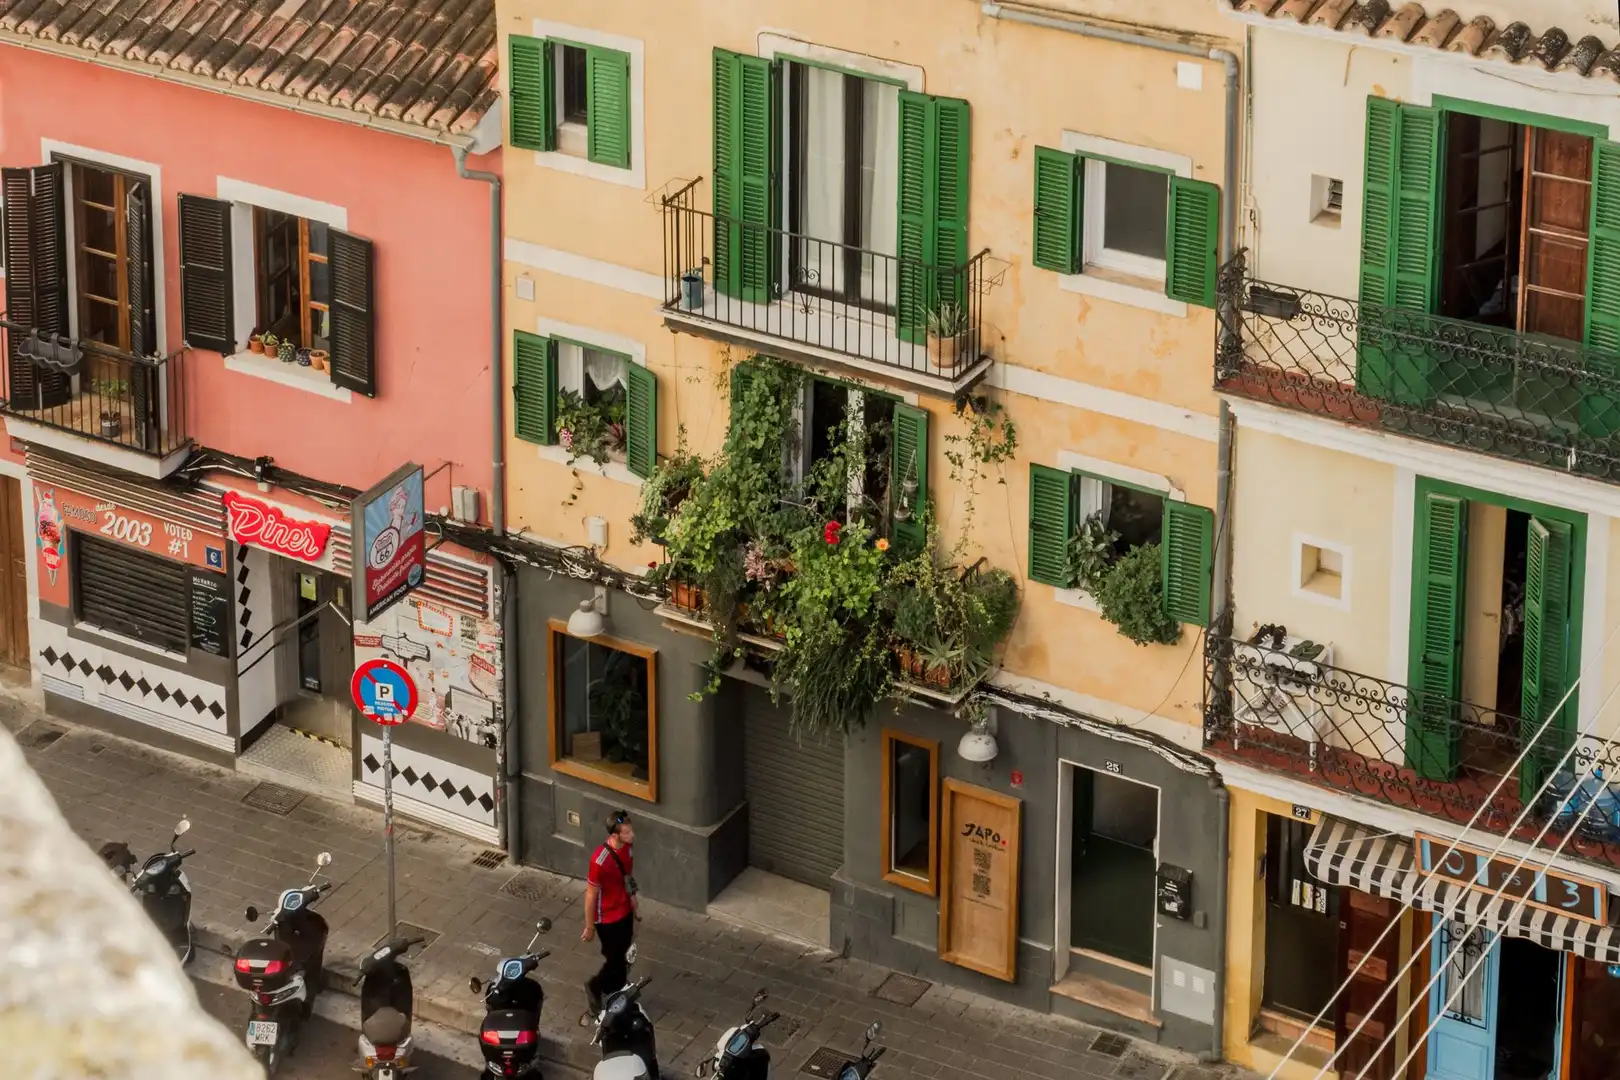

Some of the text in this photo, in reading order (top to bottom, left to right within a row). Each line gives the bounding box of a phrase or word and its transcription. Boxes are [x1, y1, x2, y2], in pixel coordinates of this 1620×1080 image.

[100, 512, 152, 546] 2003
[163, 521, 193, 541] VOTED
[230, 500, 319, 556] Diner
[167, 539, 189, 558] #1
[379, 549, 390, 561] 66
[392, 584, 408, 600] FOOD
[380, 685, 390, 698] P
[1106, 761, 1120, 773] 25
[1295, 807, 1308, 818] 27
[960, 823, 1001, 843] JAPO
